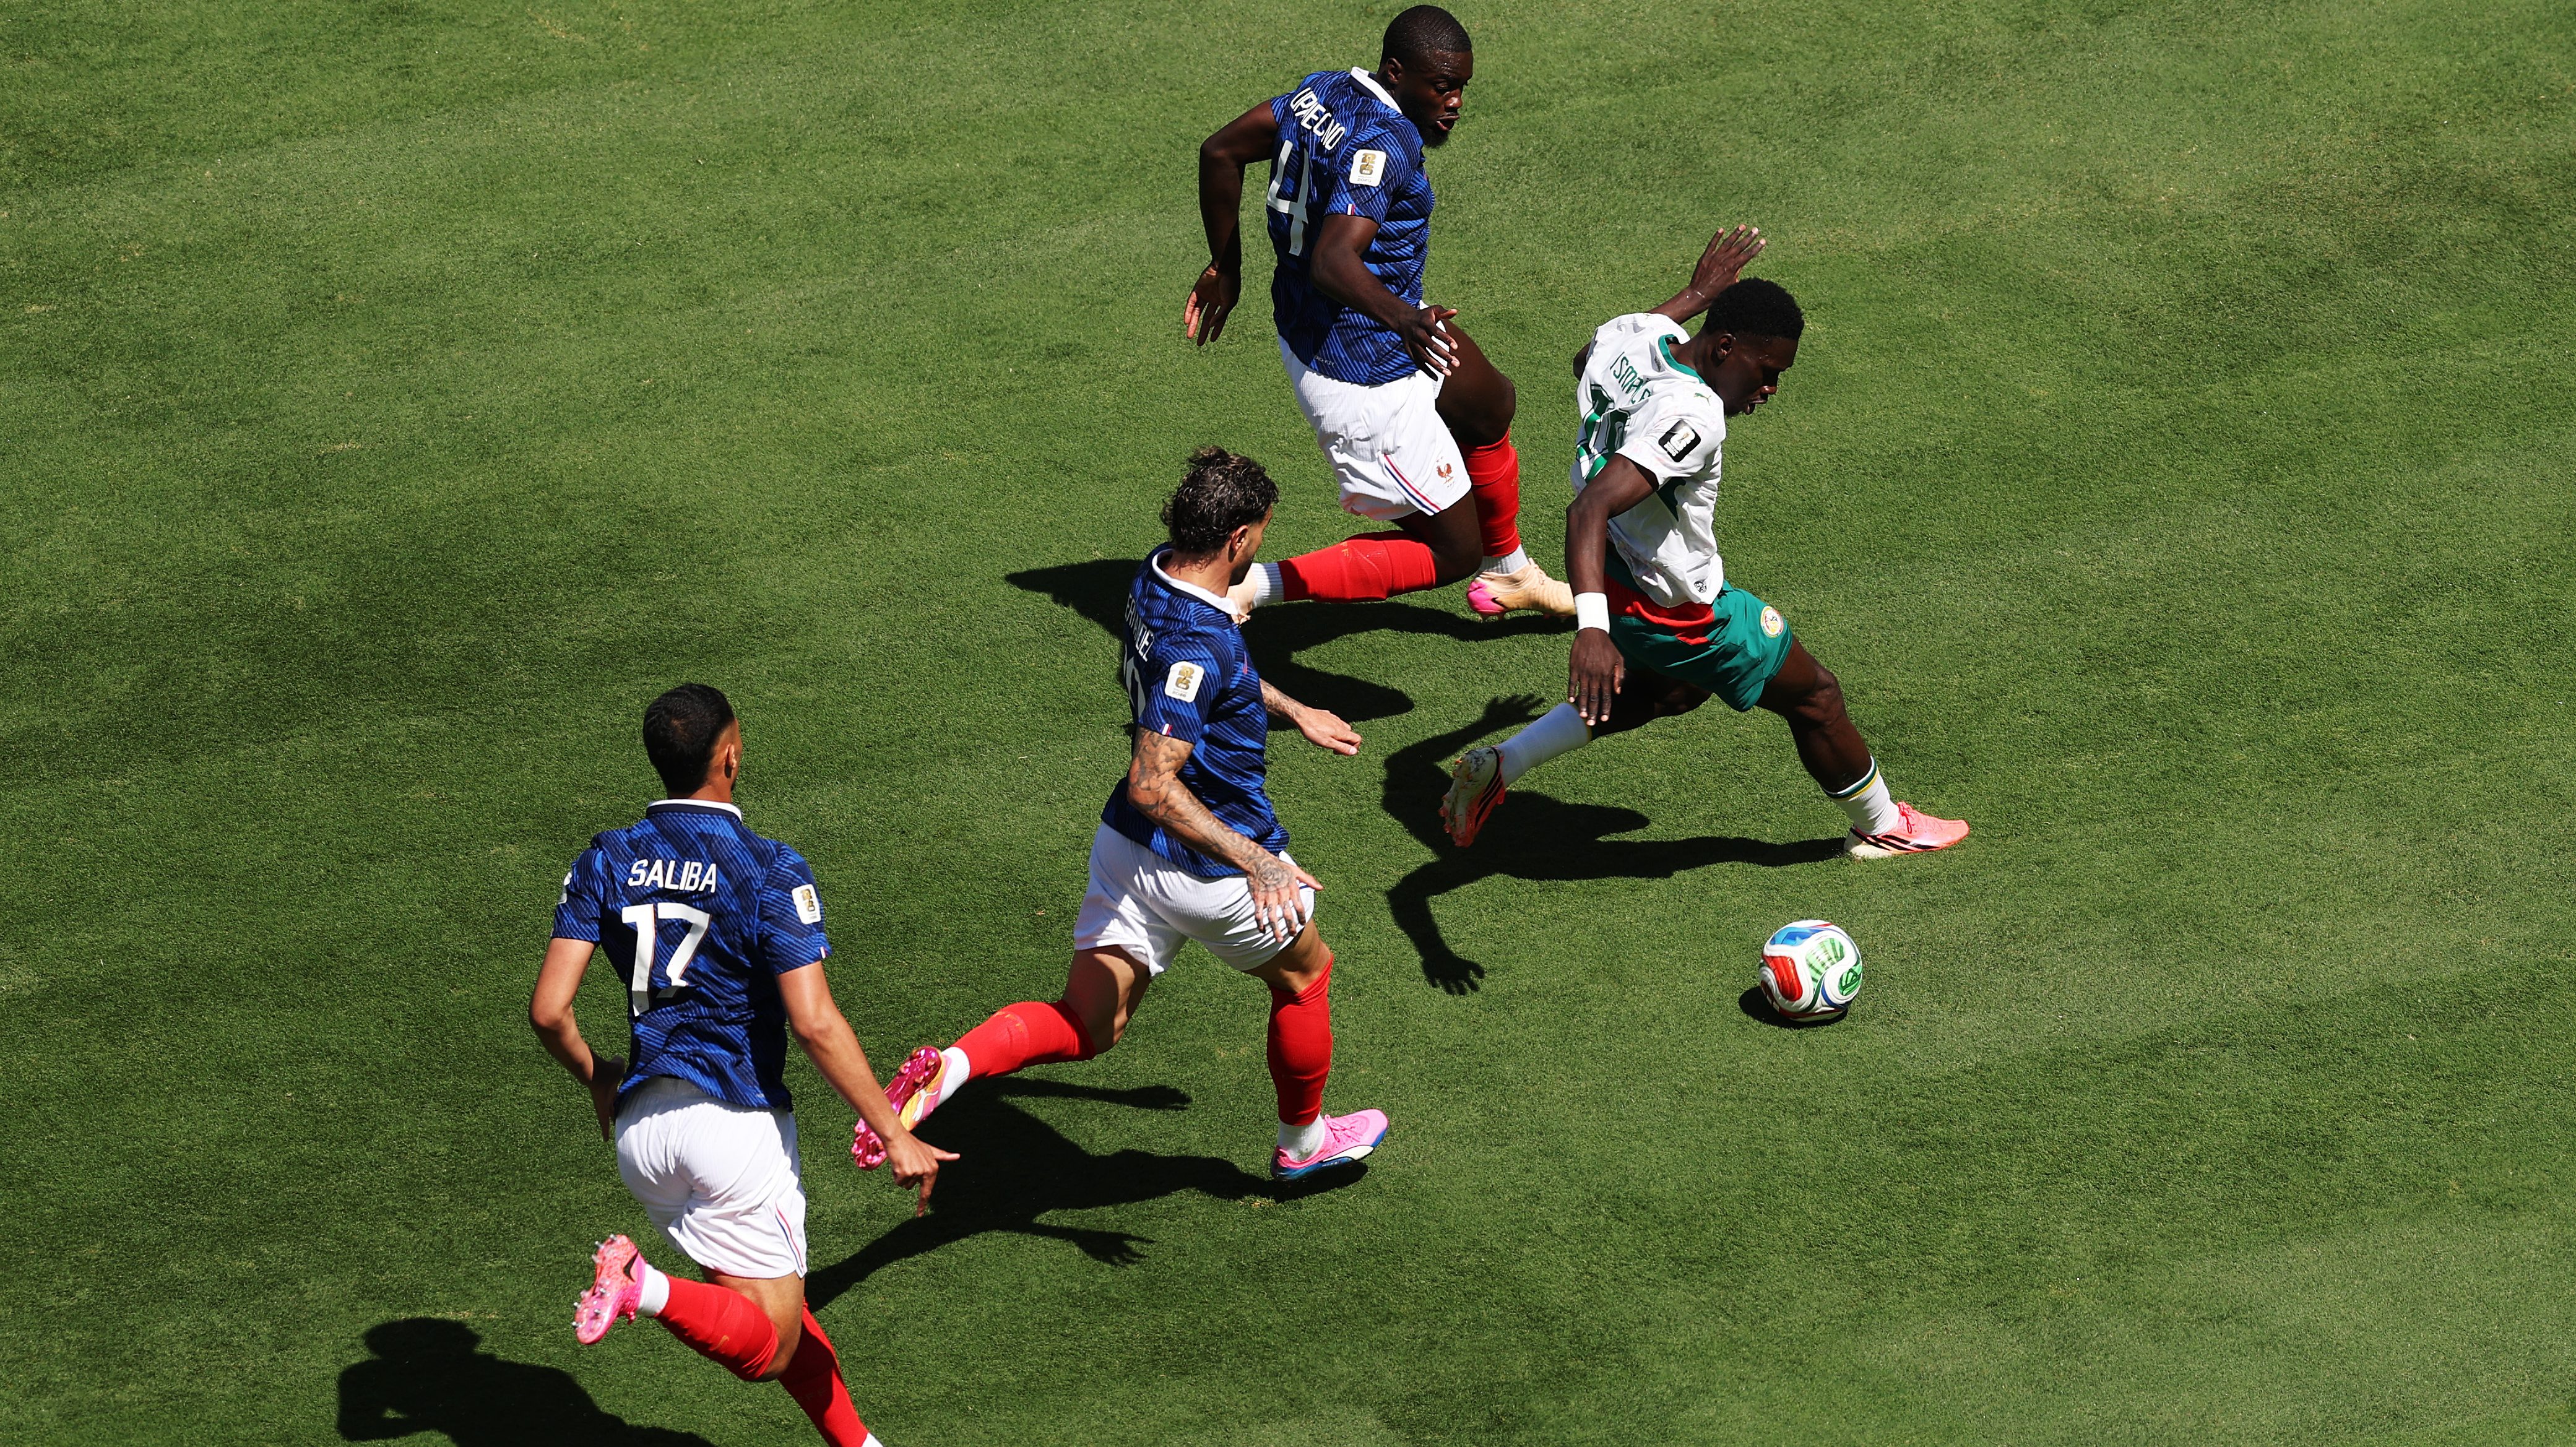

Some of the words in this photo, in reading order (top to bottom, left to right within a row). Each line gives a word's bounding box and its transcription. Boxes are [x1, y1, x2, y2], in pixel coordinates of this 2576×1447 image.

[1267, 140, 1309, 256] 4
[628, 858, 717, 893] SALIBA
[621, 902, 712, 1017] 17
